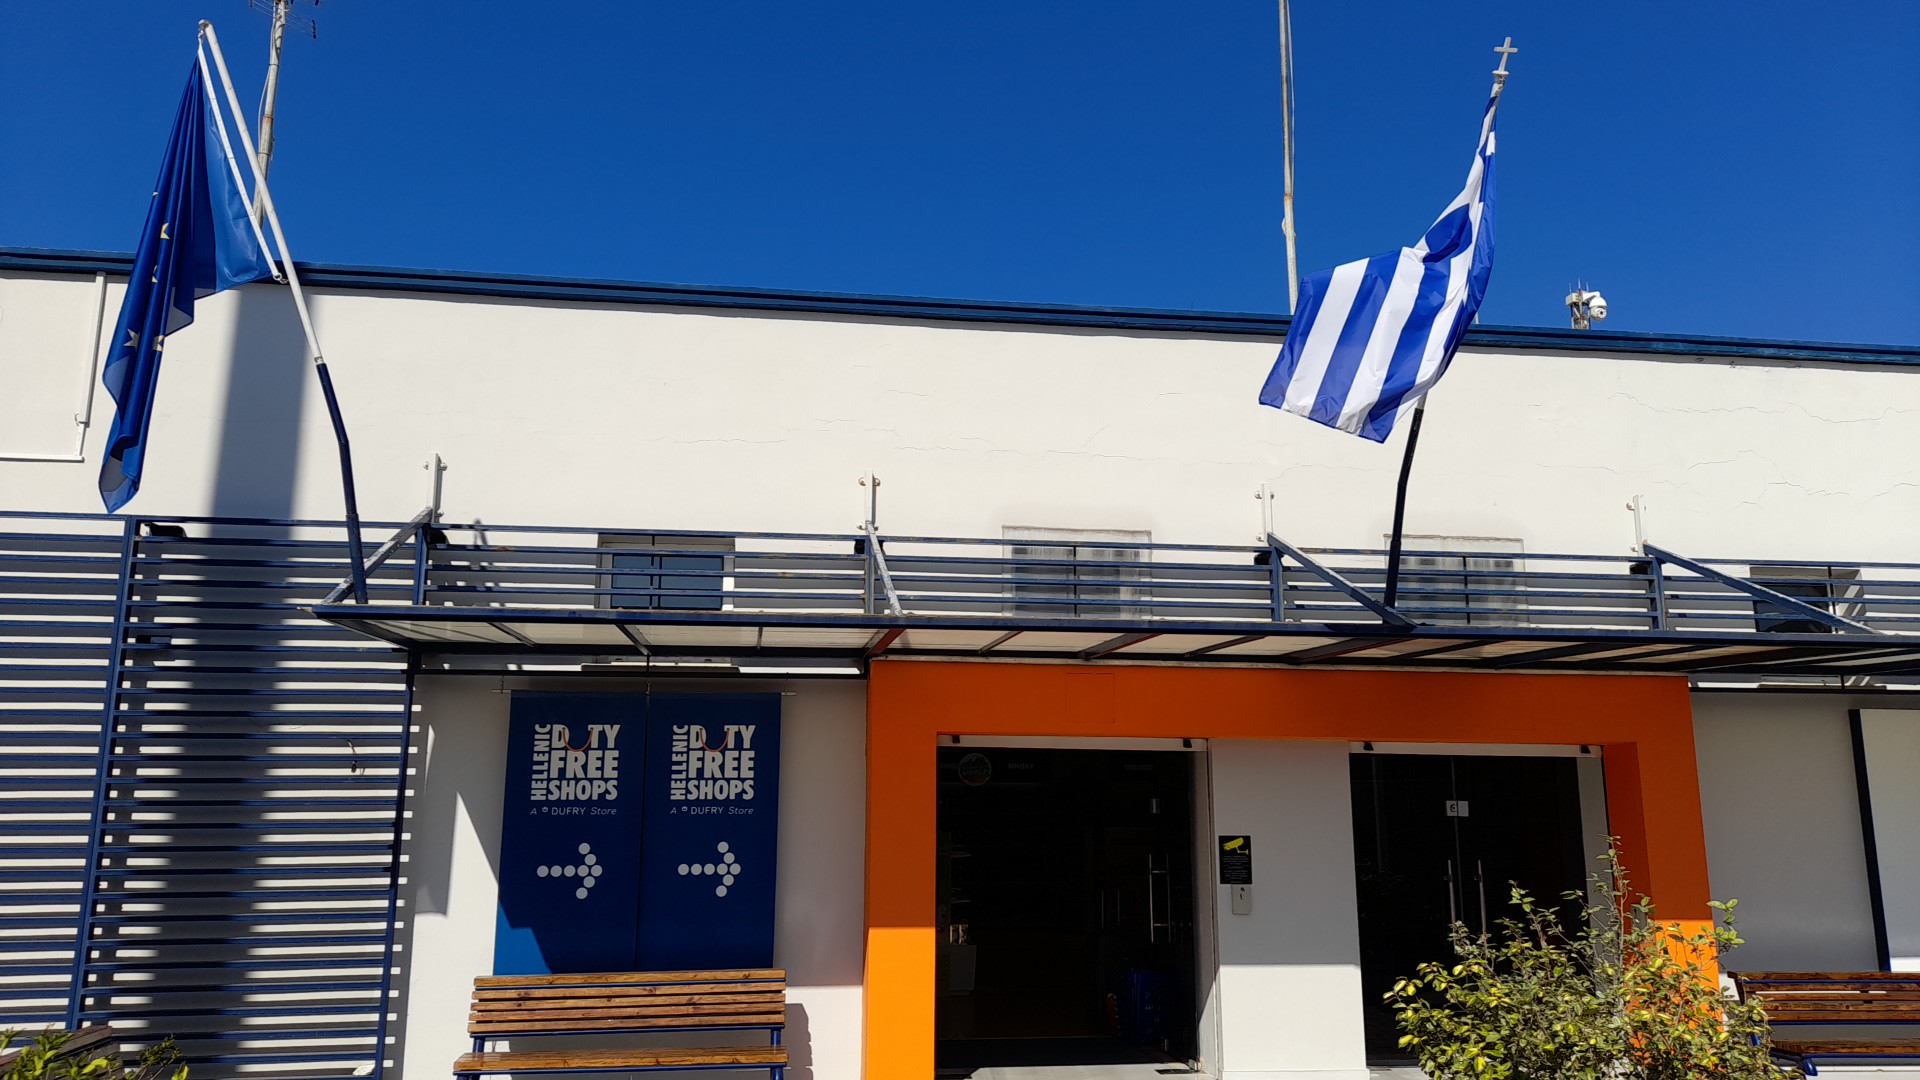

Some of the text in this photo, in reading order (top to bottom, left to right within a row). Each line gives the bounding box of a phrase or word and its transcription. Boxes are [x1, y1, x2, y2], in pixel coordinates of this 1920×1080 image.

[531, 723, 551, 801] HELLENIC
[549, 750, 619, 779] FREE
[670, 724, 689, 801] HELLENIC
[688, 750, 755, 779] FREE
[547, 779, 618, 801] SHOPS
[686, 779, 754, 801] SHOPS
[530, 806, 617, 815] A DUFRY Store
[669, 806, 754, 815] A DUFRY Store
